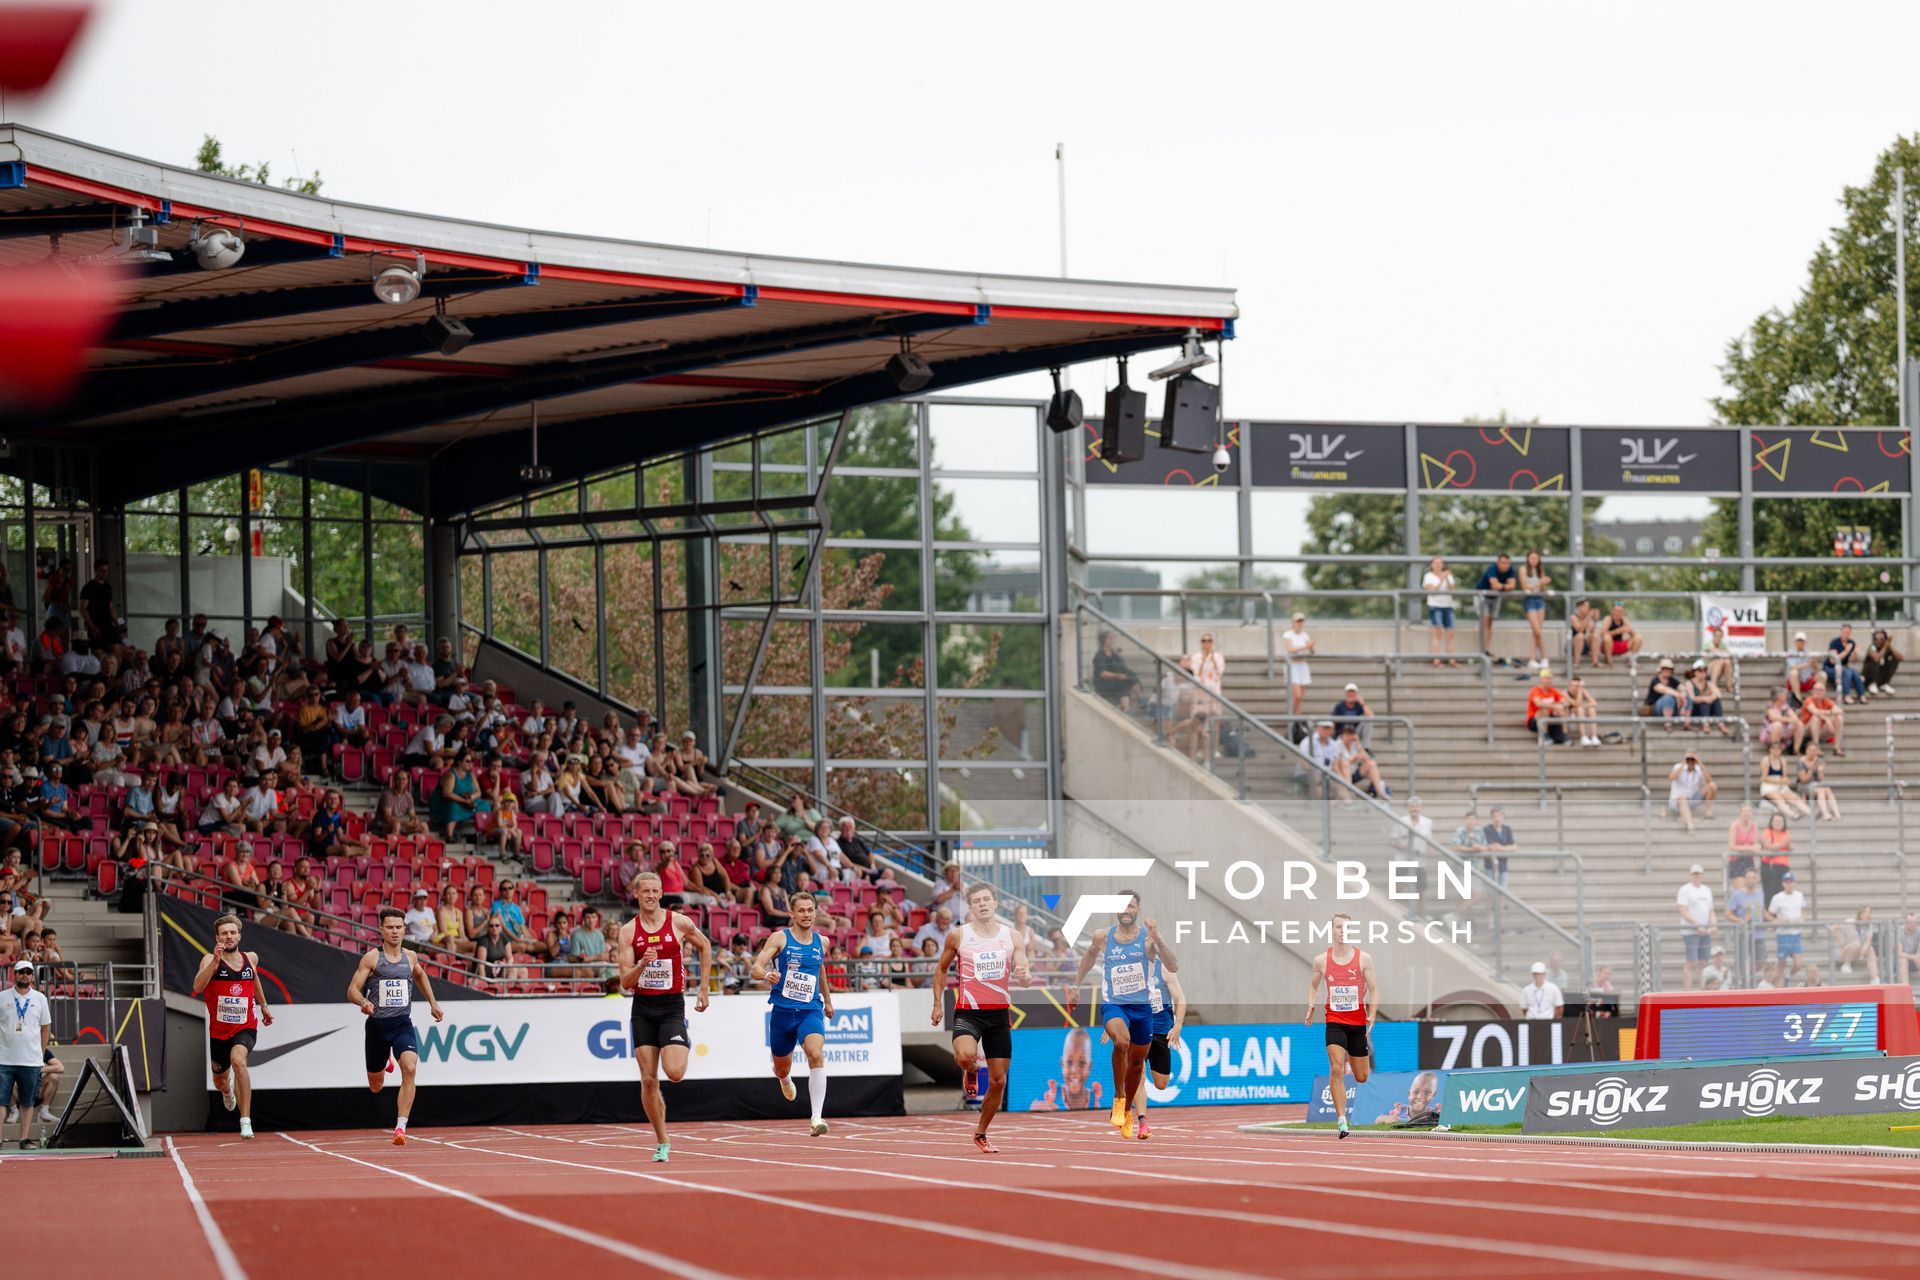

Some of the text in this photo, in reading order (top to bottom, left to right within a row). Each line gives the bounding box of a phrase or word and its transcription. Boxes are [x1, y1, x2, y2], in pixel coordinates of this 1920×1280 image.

[1733, 608, 1763, 622] VfL
[980, 952, 997, 960] GLS
[976, 961, 1004, 972] BREDAU
[1117, 965, 1134, 974] GLS
[793, 973, 808, 981] GLS
[386, 989, 403, 997] KLEI
[785, 980, 813, 993] SCHLEGEL
[824, 1014, 869, 1032] LAN
[1783, 1013, 1862, 1042] 37.7
[414, 1022, 530, 1063] WGV
[1197, 1036, 1291, 1078] PLAN
[1197, 1085, 1290, 1100] INTERNATIONAL
[1459, 1086, 1525, 1113] WGV
[1699, 1077, 1823, 1109] SHOKZ
[1547, 1084, 1669, 1117] SHOKZ
